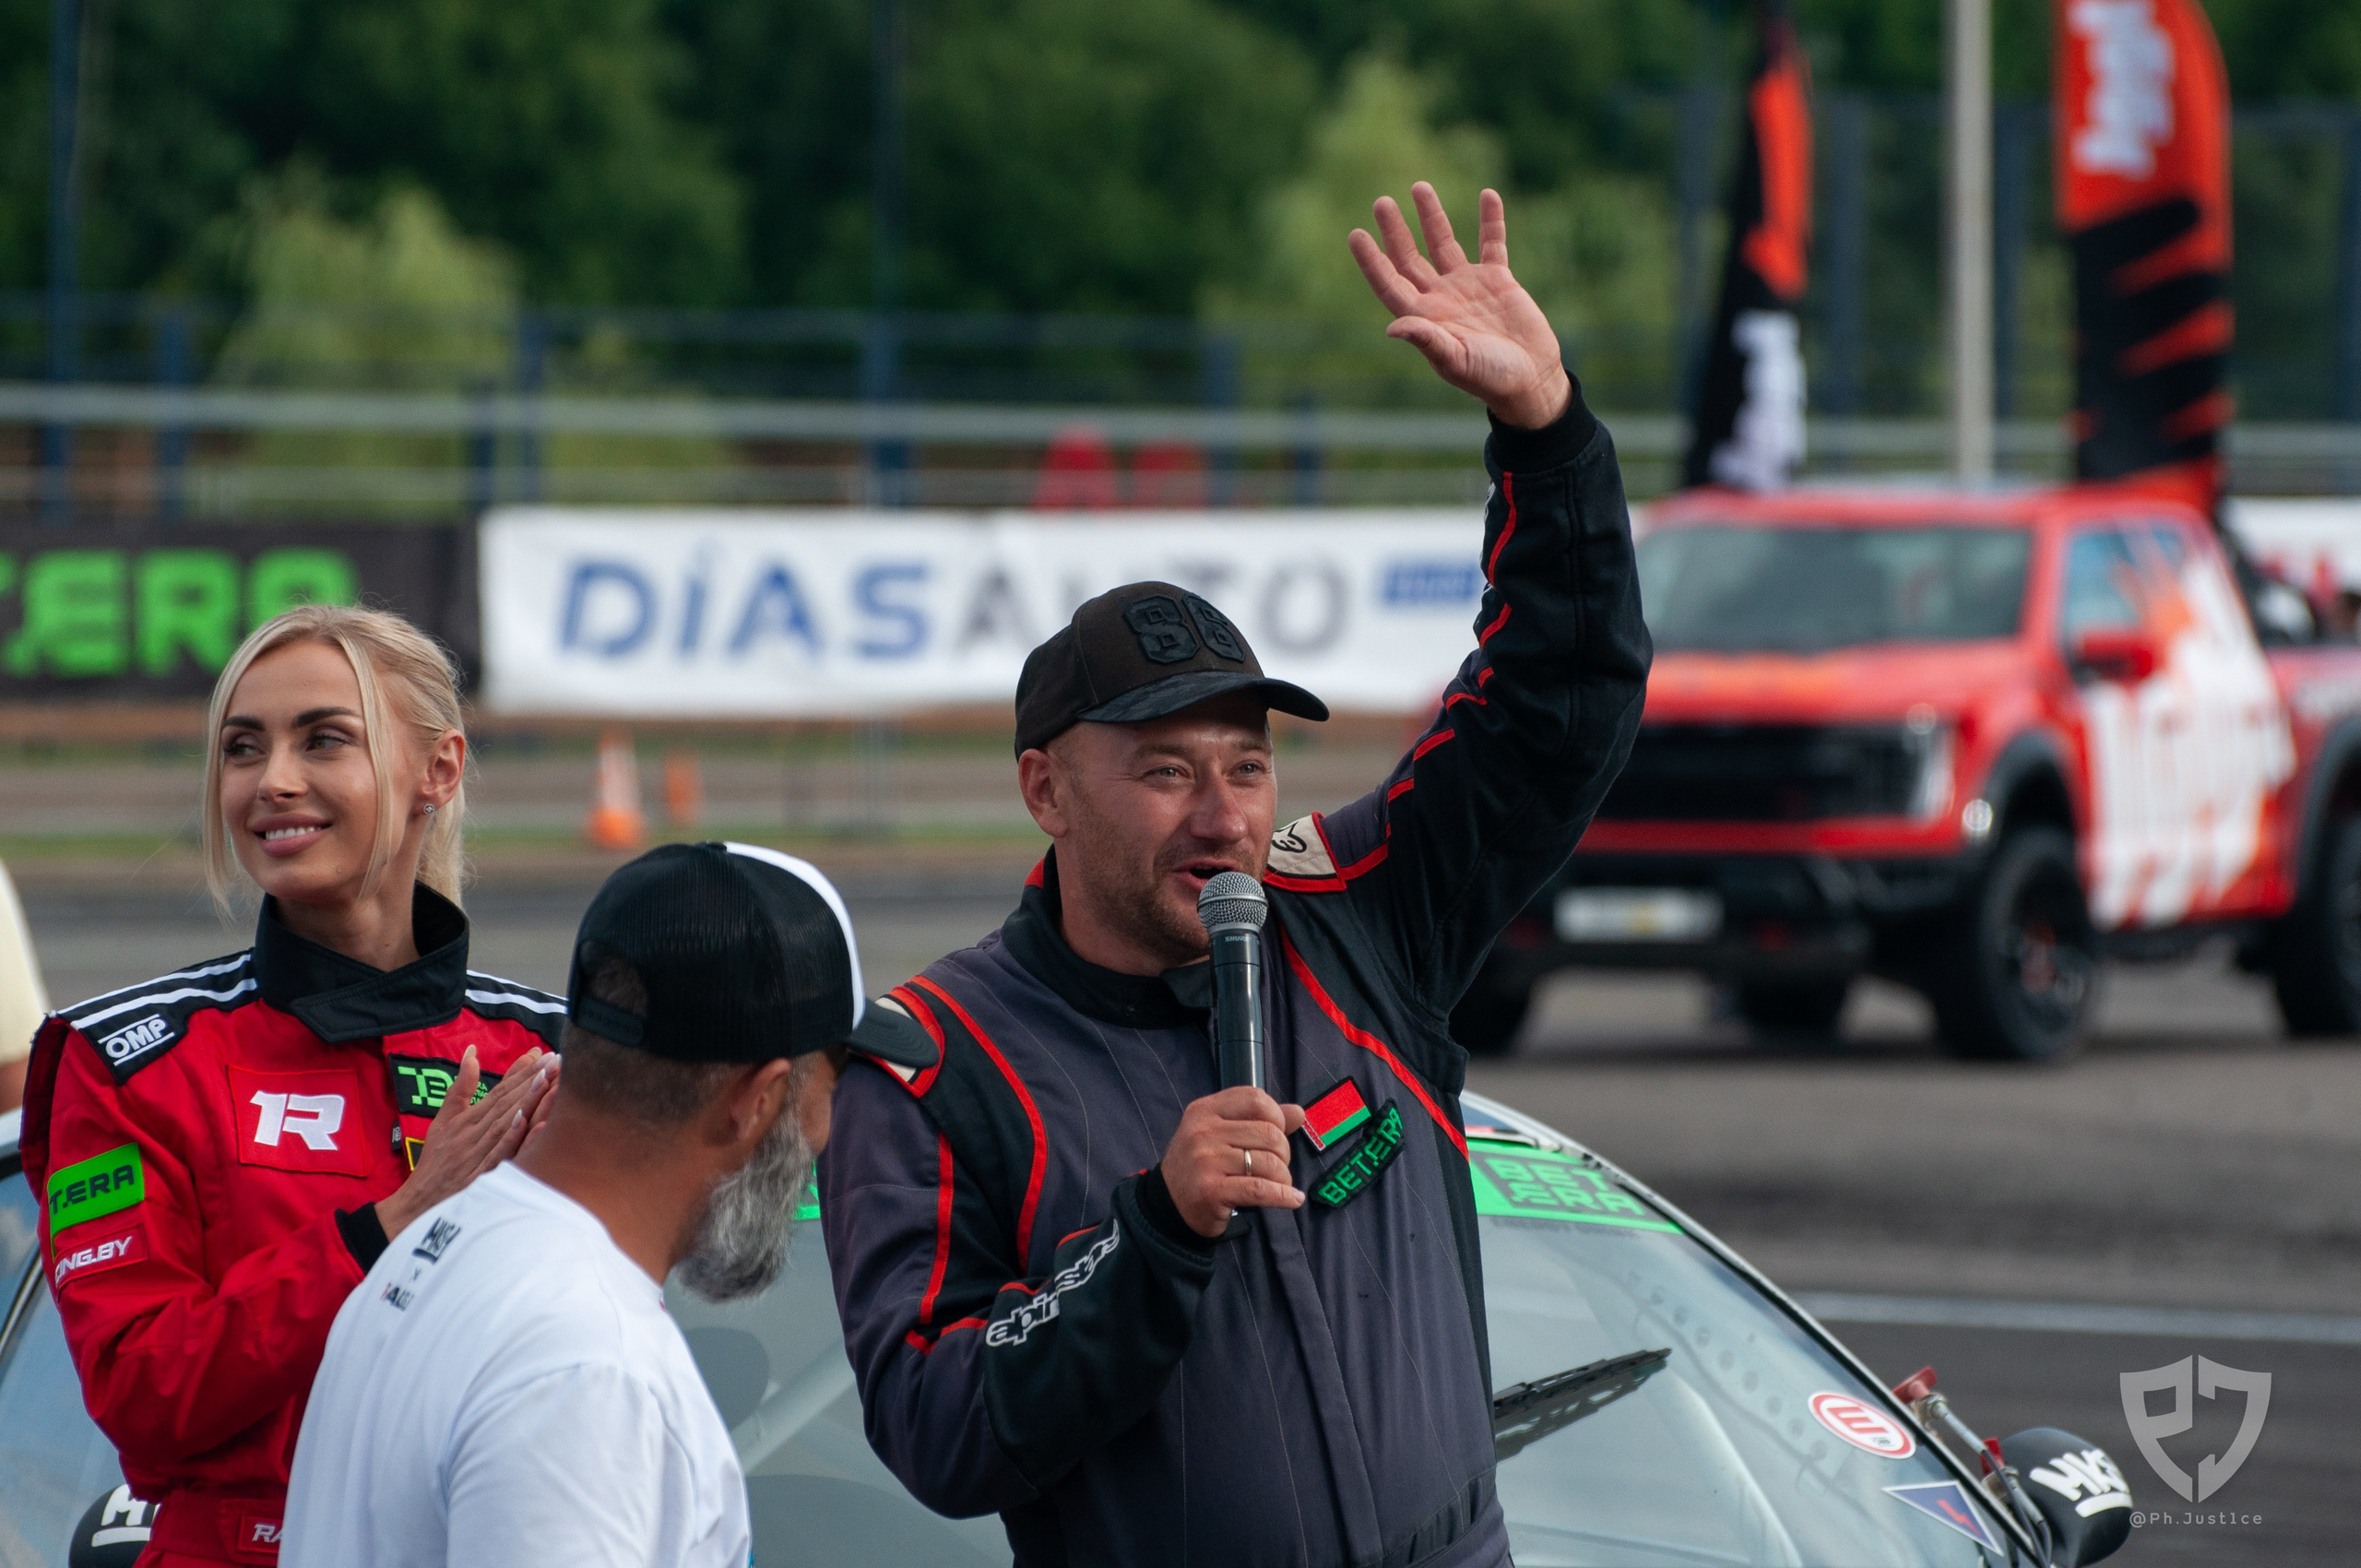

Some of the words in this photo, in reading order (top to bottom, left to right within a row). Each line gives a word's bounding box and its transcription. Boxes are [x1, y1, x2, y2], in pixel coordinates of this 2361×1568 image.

[105, 1016, 168, 1059] OMP
[1318, 1107, 1404, 1204] BET.ERA
[1485, 1157, 1609, 1193] BET
